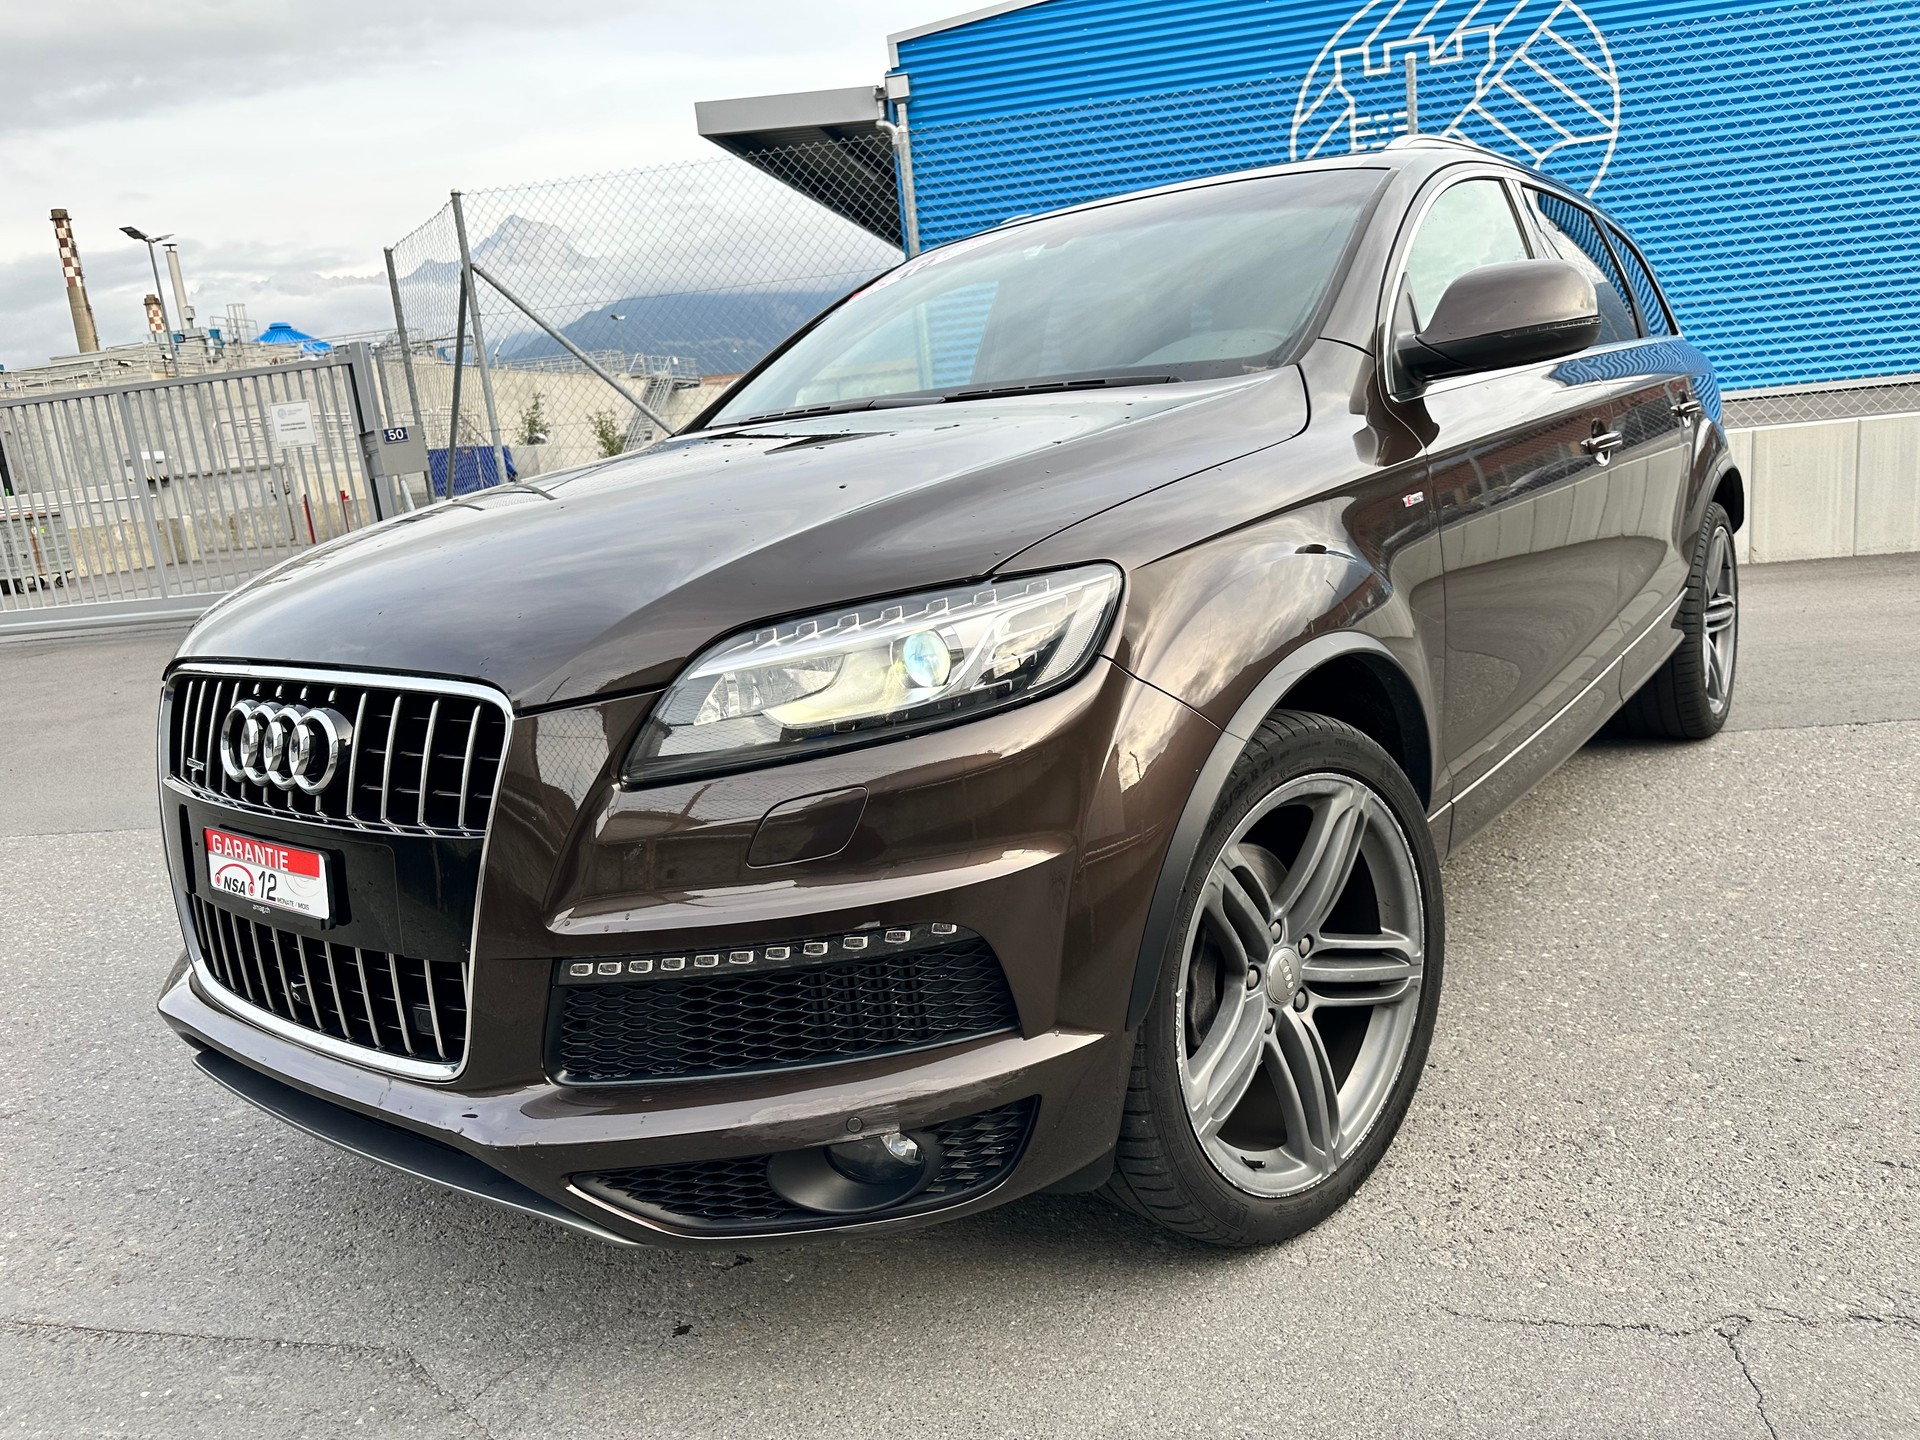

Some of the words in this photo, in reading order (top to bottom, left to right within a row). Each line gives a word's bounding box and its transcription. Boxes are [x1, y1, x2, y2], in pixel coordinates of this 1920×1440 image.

[388, 429, 404, 440] 50
[212, 834, 289, 872] GARANTIE
[223, 876, 246, 895] NSA
[258, 870, 277, 902] 12
